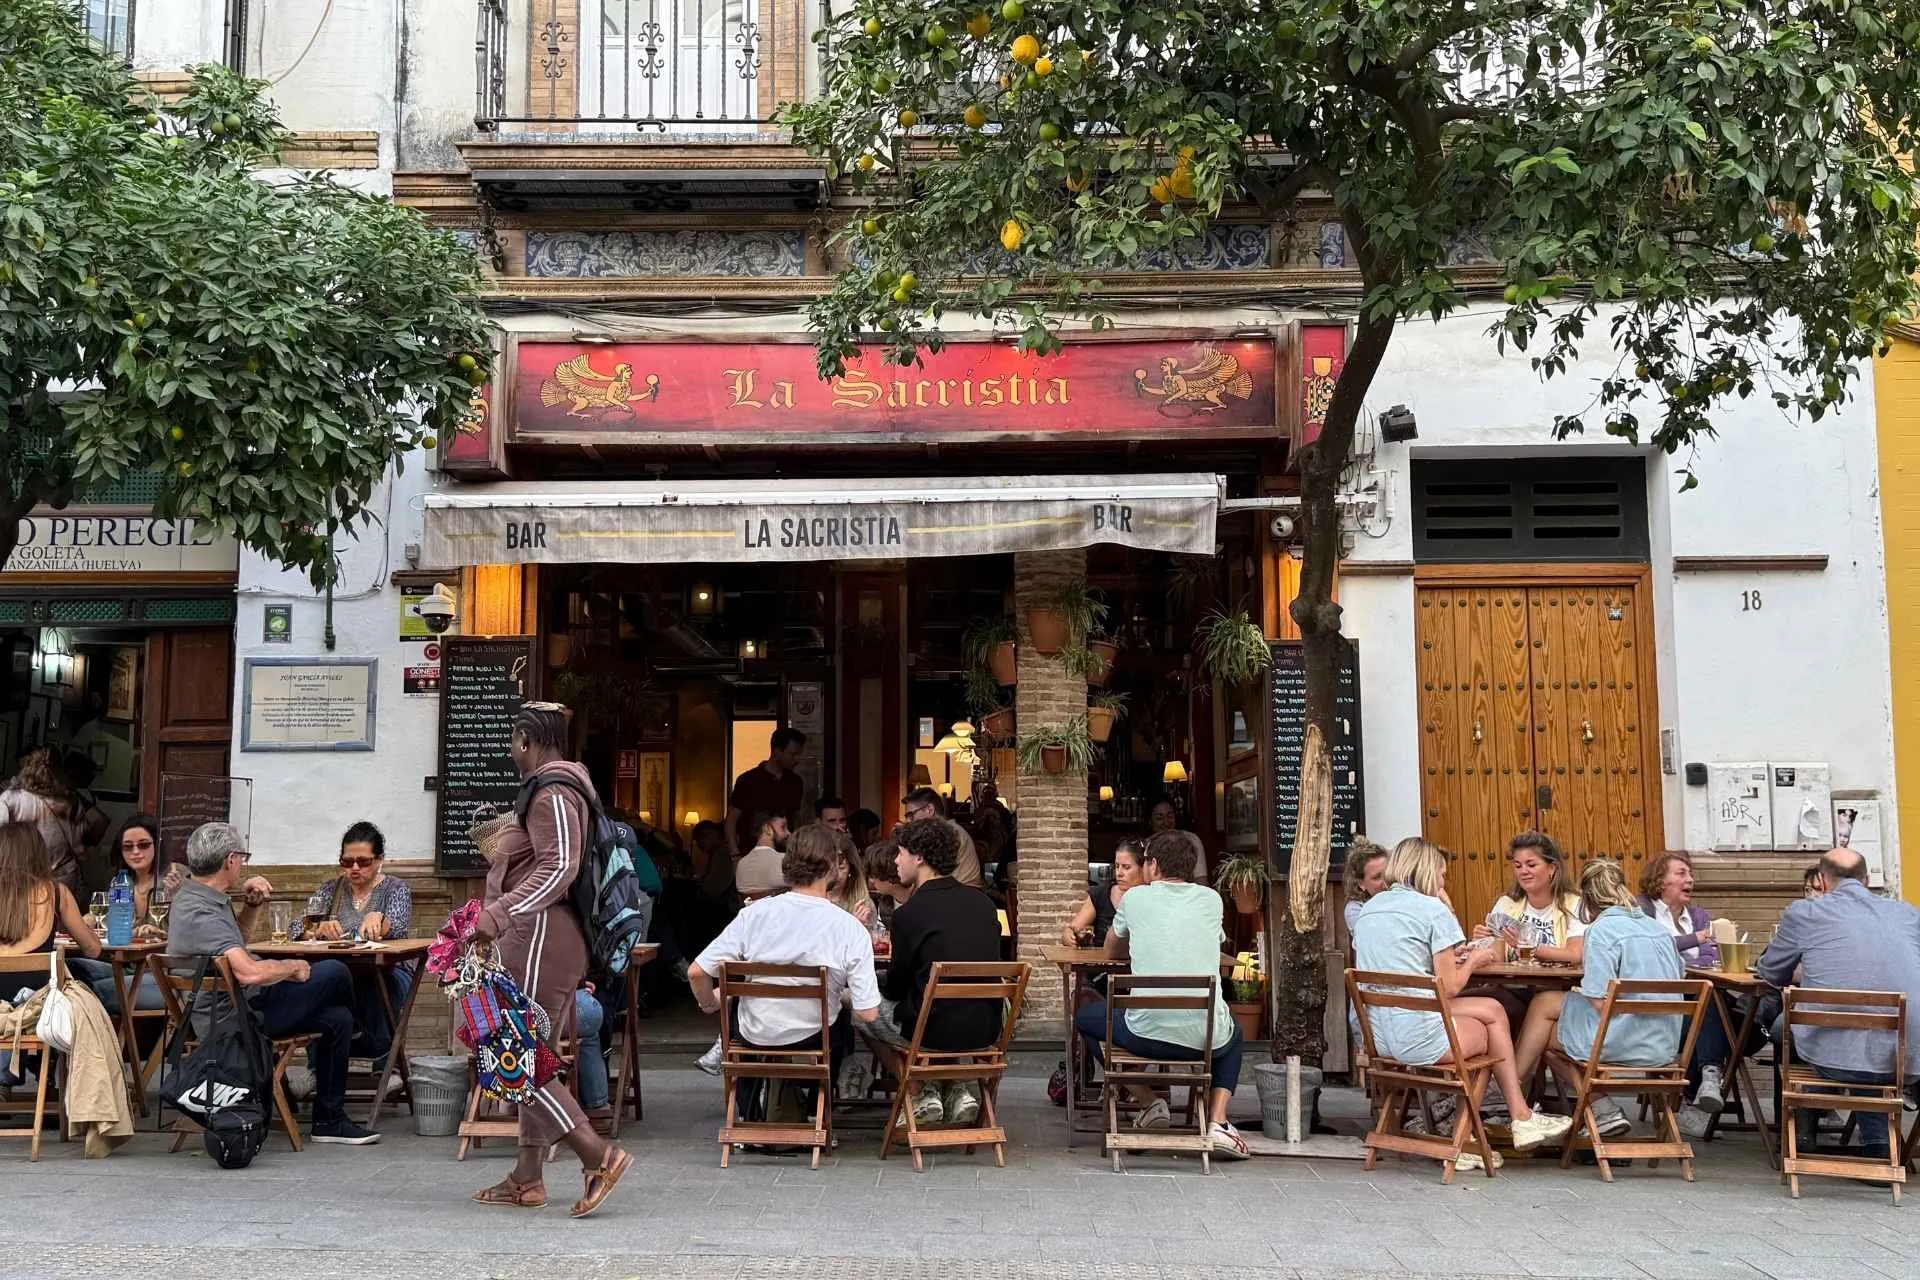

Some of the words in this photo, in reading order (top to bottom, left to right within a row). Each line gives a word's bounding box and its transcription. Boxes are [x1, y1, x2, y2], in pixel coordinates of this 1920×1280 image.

[723, 368, 797, 410] La
[1093, 502, 1132, 533] BAR
[506, 522, 546, 549] BAR
[744, 519, 772, 549] LA
[780, 515, 902, 546] SACRISTÍA
[20, 546, 86, 560] GOLETA
[81, 559, 141, 571] (HUELVA)
[1741, 590, 1762, 612] 18
[190, 1079, 250, 1108] NIKE
